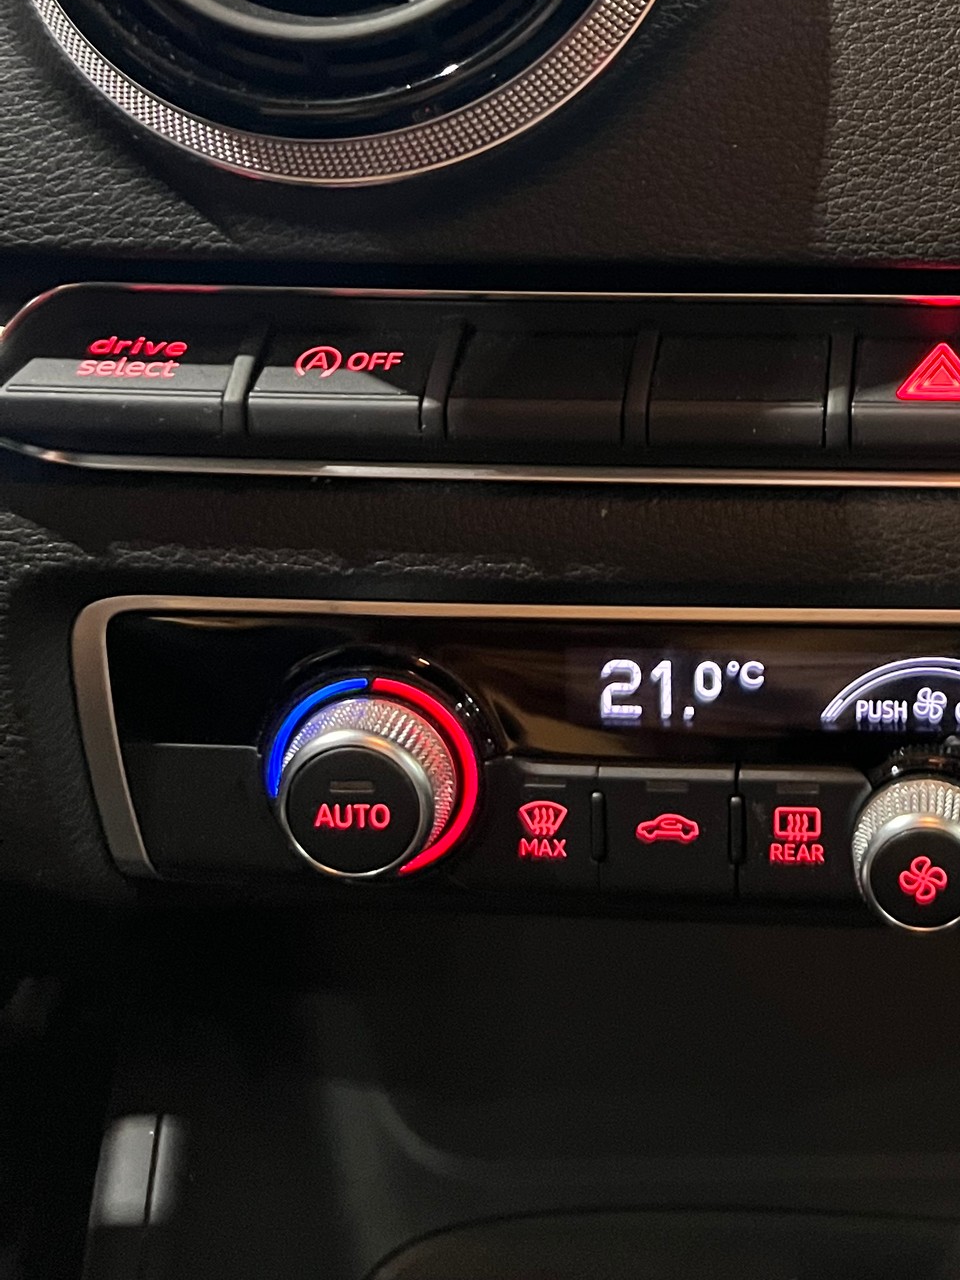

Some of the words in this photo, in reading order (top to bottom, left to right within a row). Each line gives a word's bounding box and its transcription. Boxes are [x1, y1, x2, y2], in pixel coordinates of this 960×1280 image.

[88, 335, 188, 359] drive
[77, 357, 179, 380] select
[346, 351, 404, 373] OFF
[856, 699, 908, 722] PUSH
[314, 803, 391, 831] AUTO
[519, 836, 568, 859] MAX
[769, 842, 825, 864] REAR
